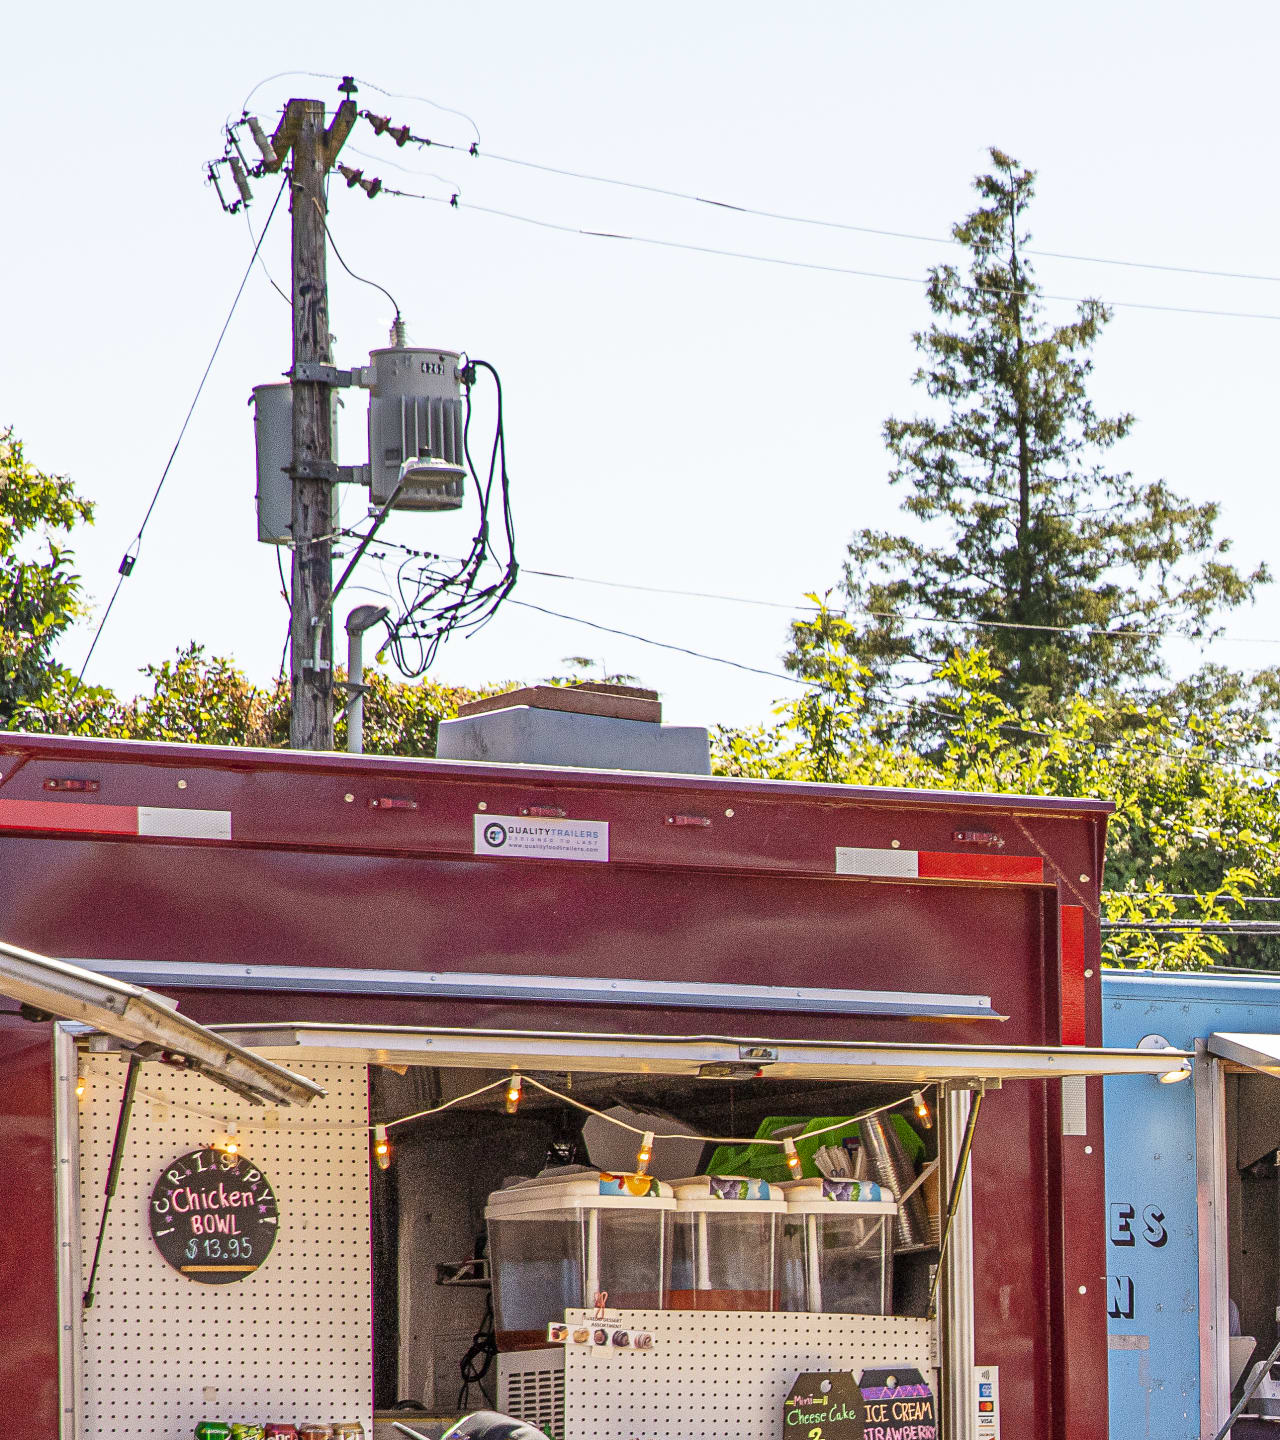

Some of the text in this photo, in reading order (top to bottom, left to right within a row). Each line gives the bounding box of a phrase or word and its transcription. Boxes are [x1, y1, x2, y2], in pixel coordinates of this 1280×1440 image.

[172, 1182, 255, 1213] Chicken
[192, 1214, 242, 1235] BOWL
[1110, 1203, 1168, 1248] ES
[787, 1403, 857, 1426] Cheese Cake
[865, 1401, 933, 1423] ICE CREAM
